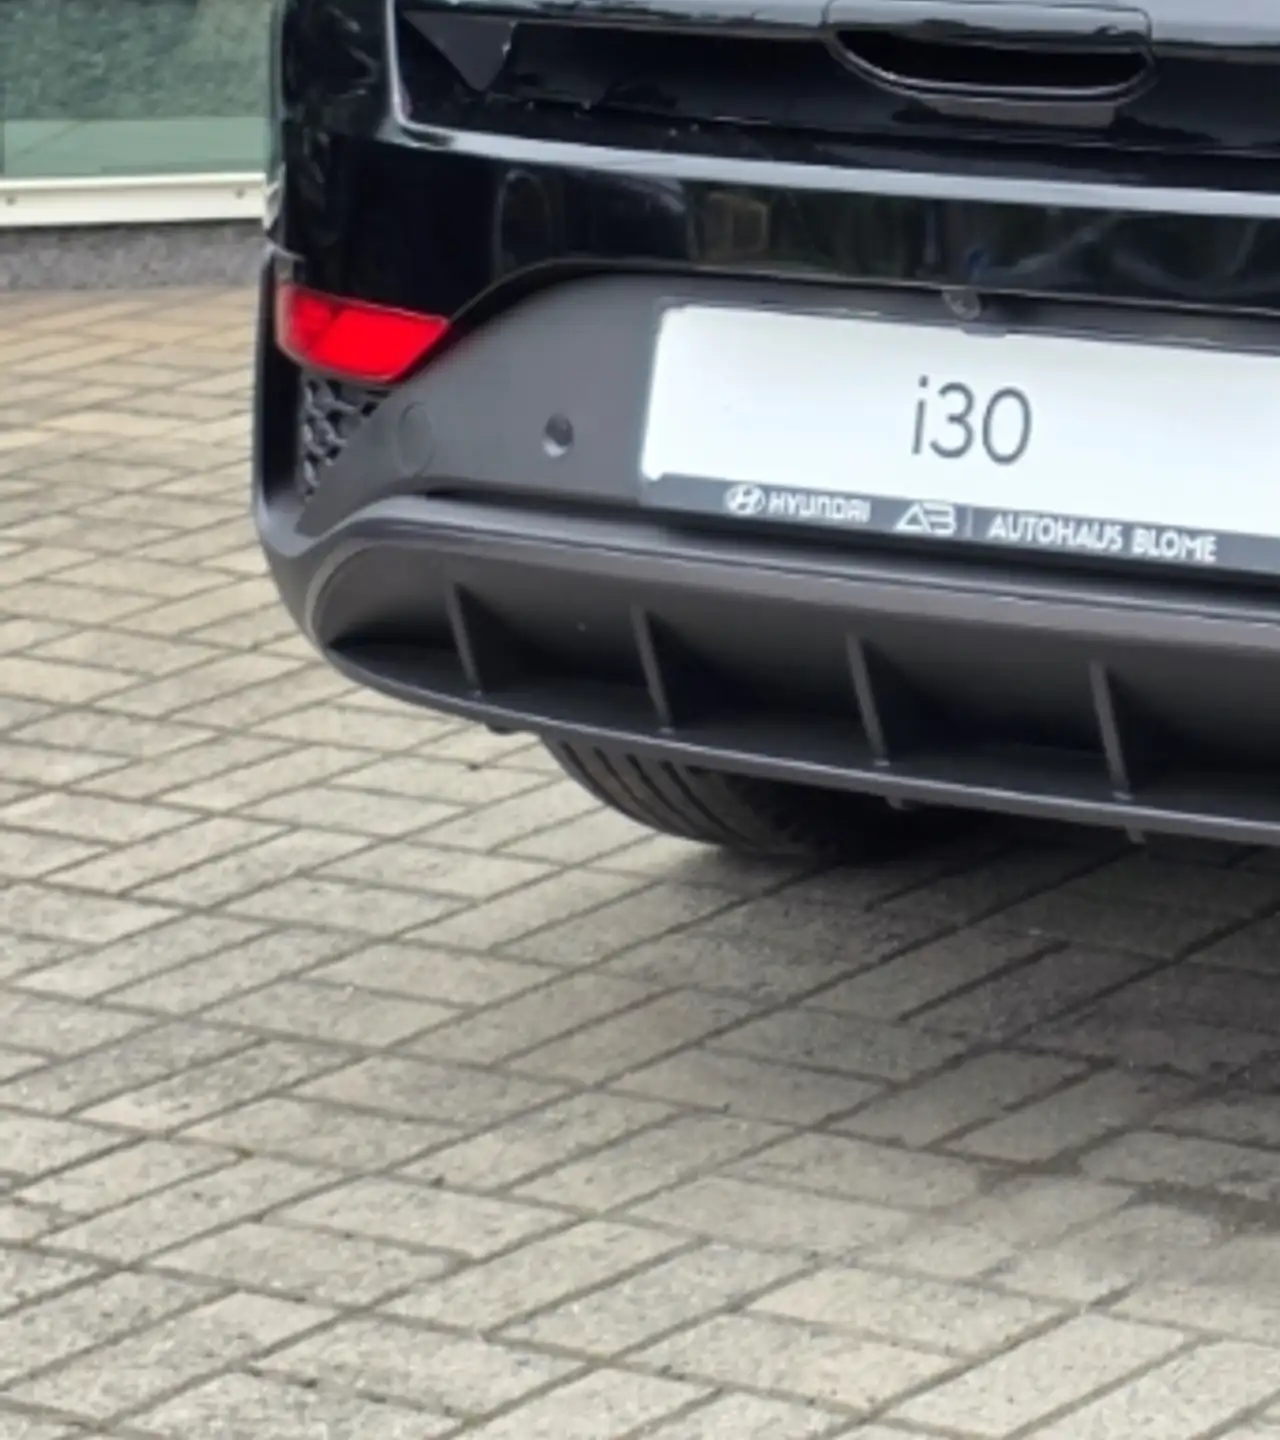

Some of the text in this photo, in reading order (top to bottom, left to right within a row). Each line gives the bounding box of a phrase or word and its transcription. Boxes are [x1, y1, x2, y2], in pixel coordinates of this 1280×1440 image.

[910, 374, 1032, 466] i30
[768, 490, 872, 525] HYUNDAI
[987, 513, 1124, 553] AUTOHAUS
[1131, 527, 1218, 563] BLOME
